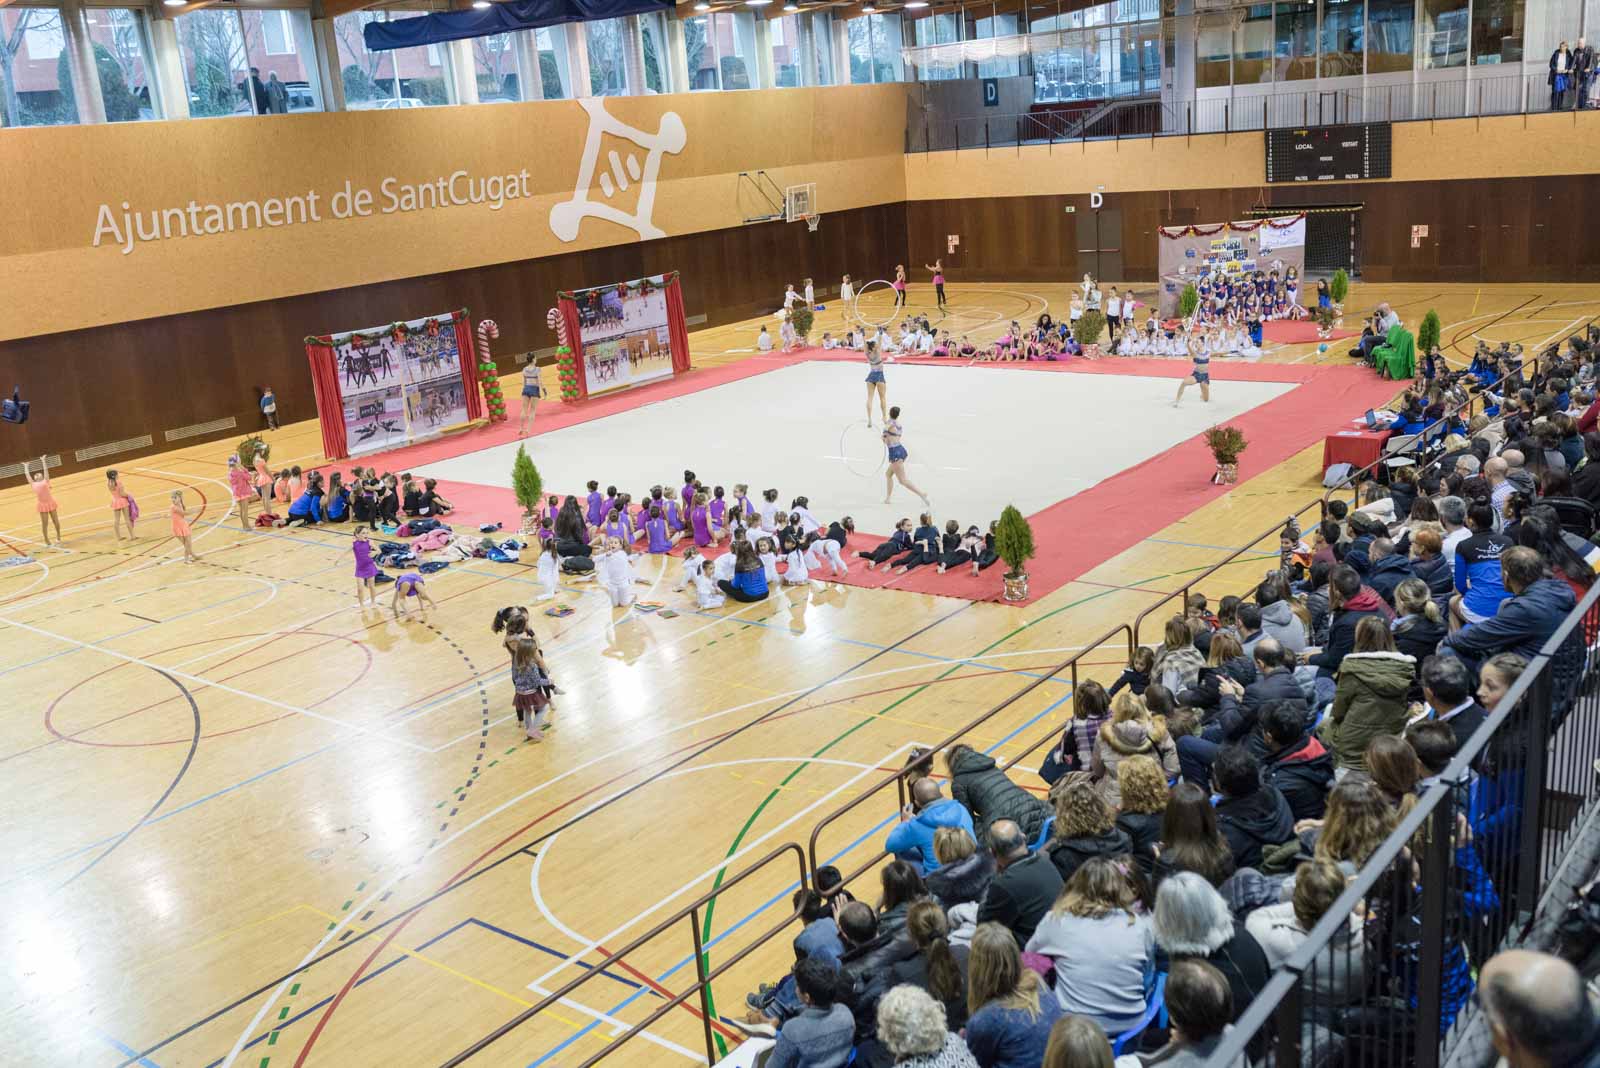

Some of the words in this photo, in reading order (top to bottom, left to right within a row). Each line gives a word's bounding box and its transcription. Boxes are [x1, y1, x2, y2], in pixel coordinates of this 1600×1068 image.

[986, 82, 996, 101] D
[1090, 192, 1103, 208] D
[93, 190, 320, 255] Ajuntament
[331, 180, 374, 217] de
[381, 168, 532, 213] SantCugat
